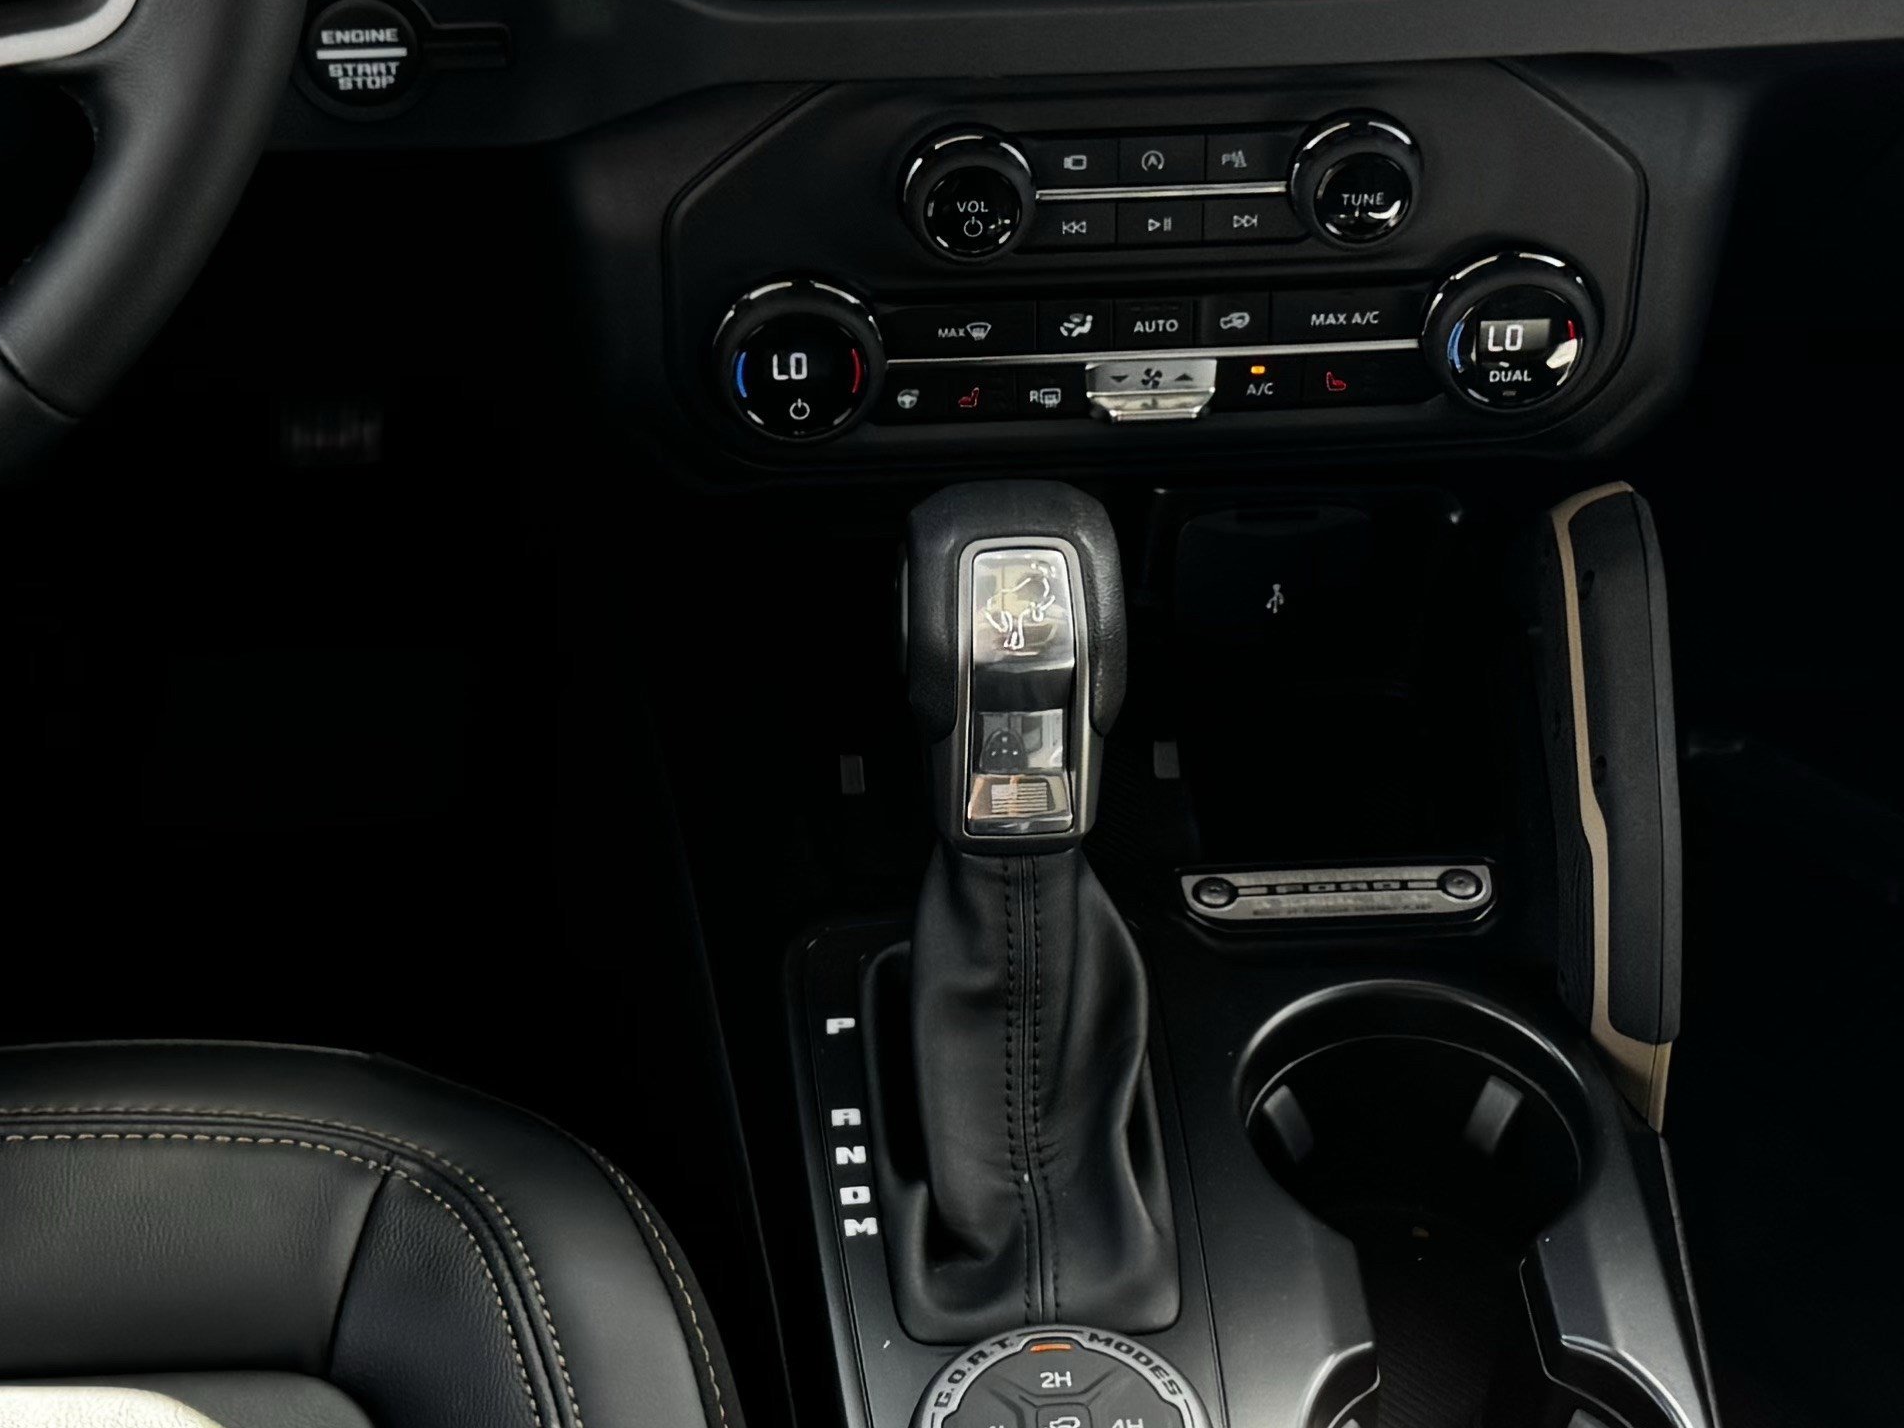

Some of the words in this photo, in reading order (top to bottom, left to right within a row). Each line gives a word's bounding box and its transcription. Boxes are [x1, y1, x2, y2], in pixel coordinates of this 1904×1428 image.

[321, 28, 399, 44] ENGINE
[328, 62, 400, 78] START
[338, 76, 395, 91] STOP
[957, 200, 989, 214] VOL
[1342, 192, 1385, 207] TUNE
[1134, 319, 1178, 334] AUTO
[1310, 313, 1346, 327] MAX
[1351, 310, 1380, 325] A/C
[937, 328, 965, 339] MAX
[1487, 324, 1524, 353] LO
[772, 352, 808, 381] LO
[1489, 370, 1532, 383] DUAL
[1030, 390, 1039, 403] R
[1246, 382, 1274, 396] A/C
[826, 1018, 855, 1034] P
[835, 1146, 866, 1164] N
[840, 1186, 871, 1205] D
[844, 1217, 878, 1237] M
[1087, 1332, 1182, 1396] MODES
[1040, 1371, 1072, 1388] 2H
